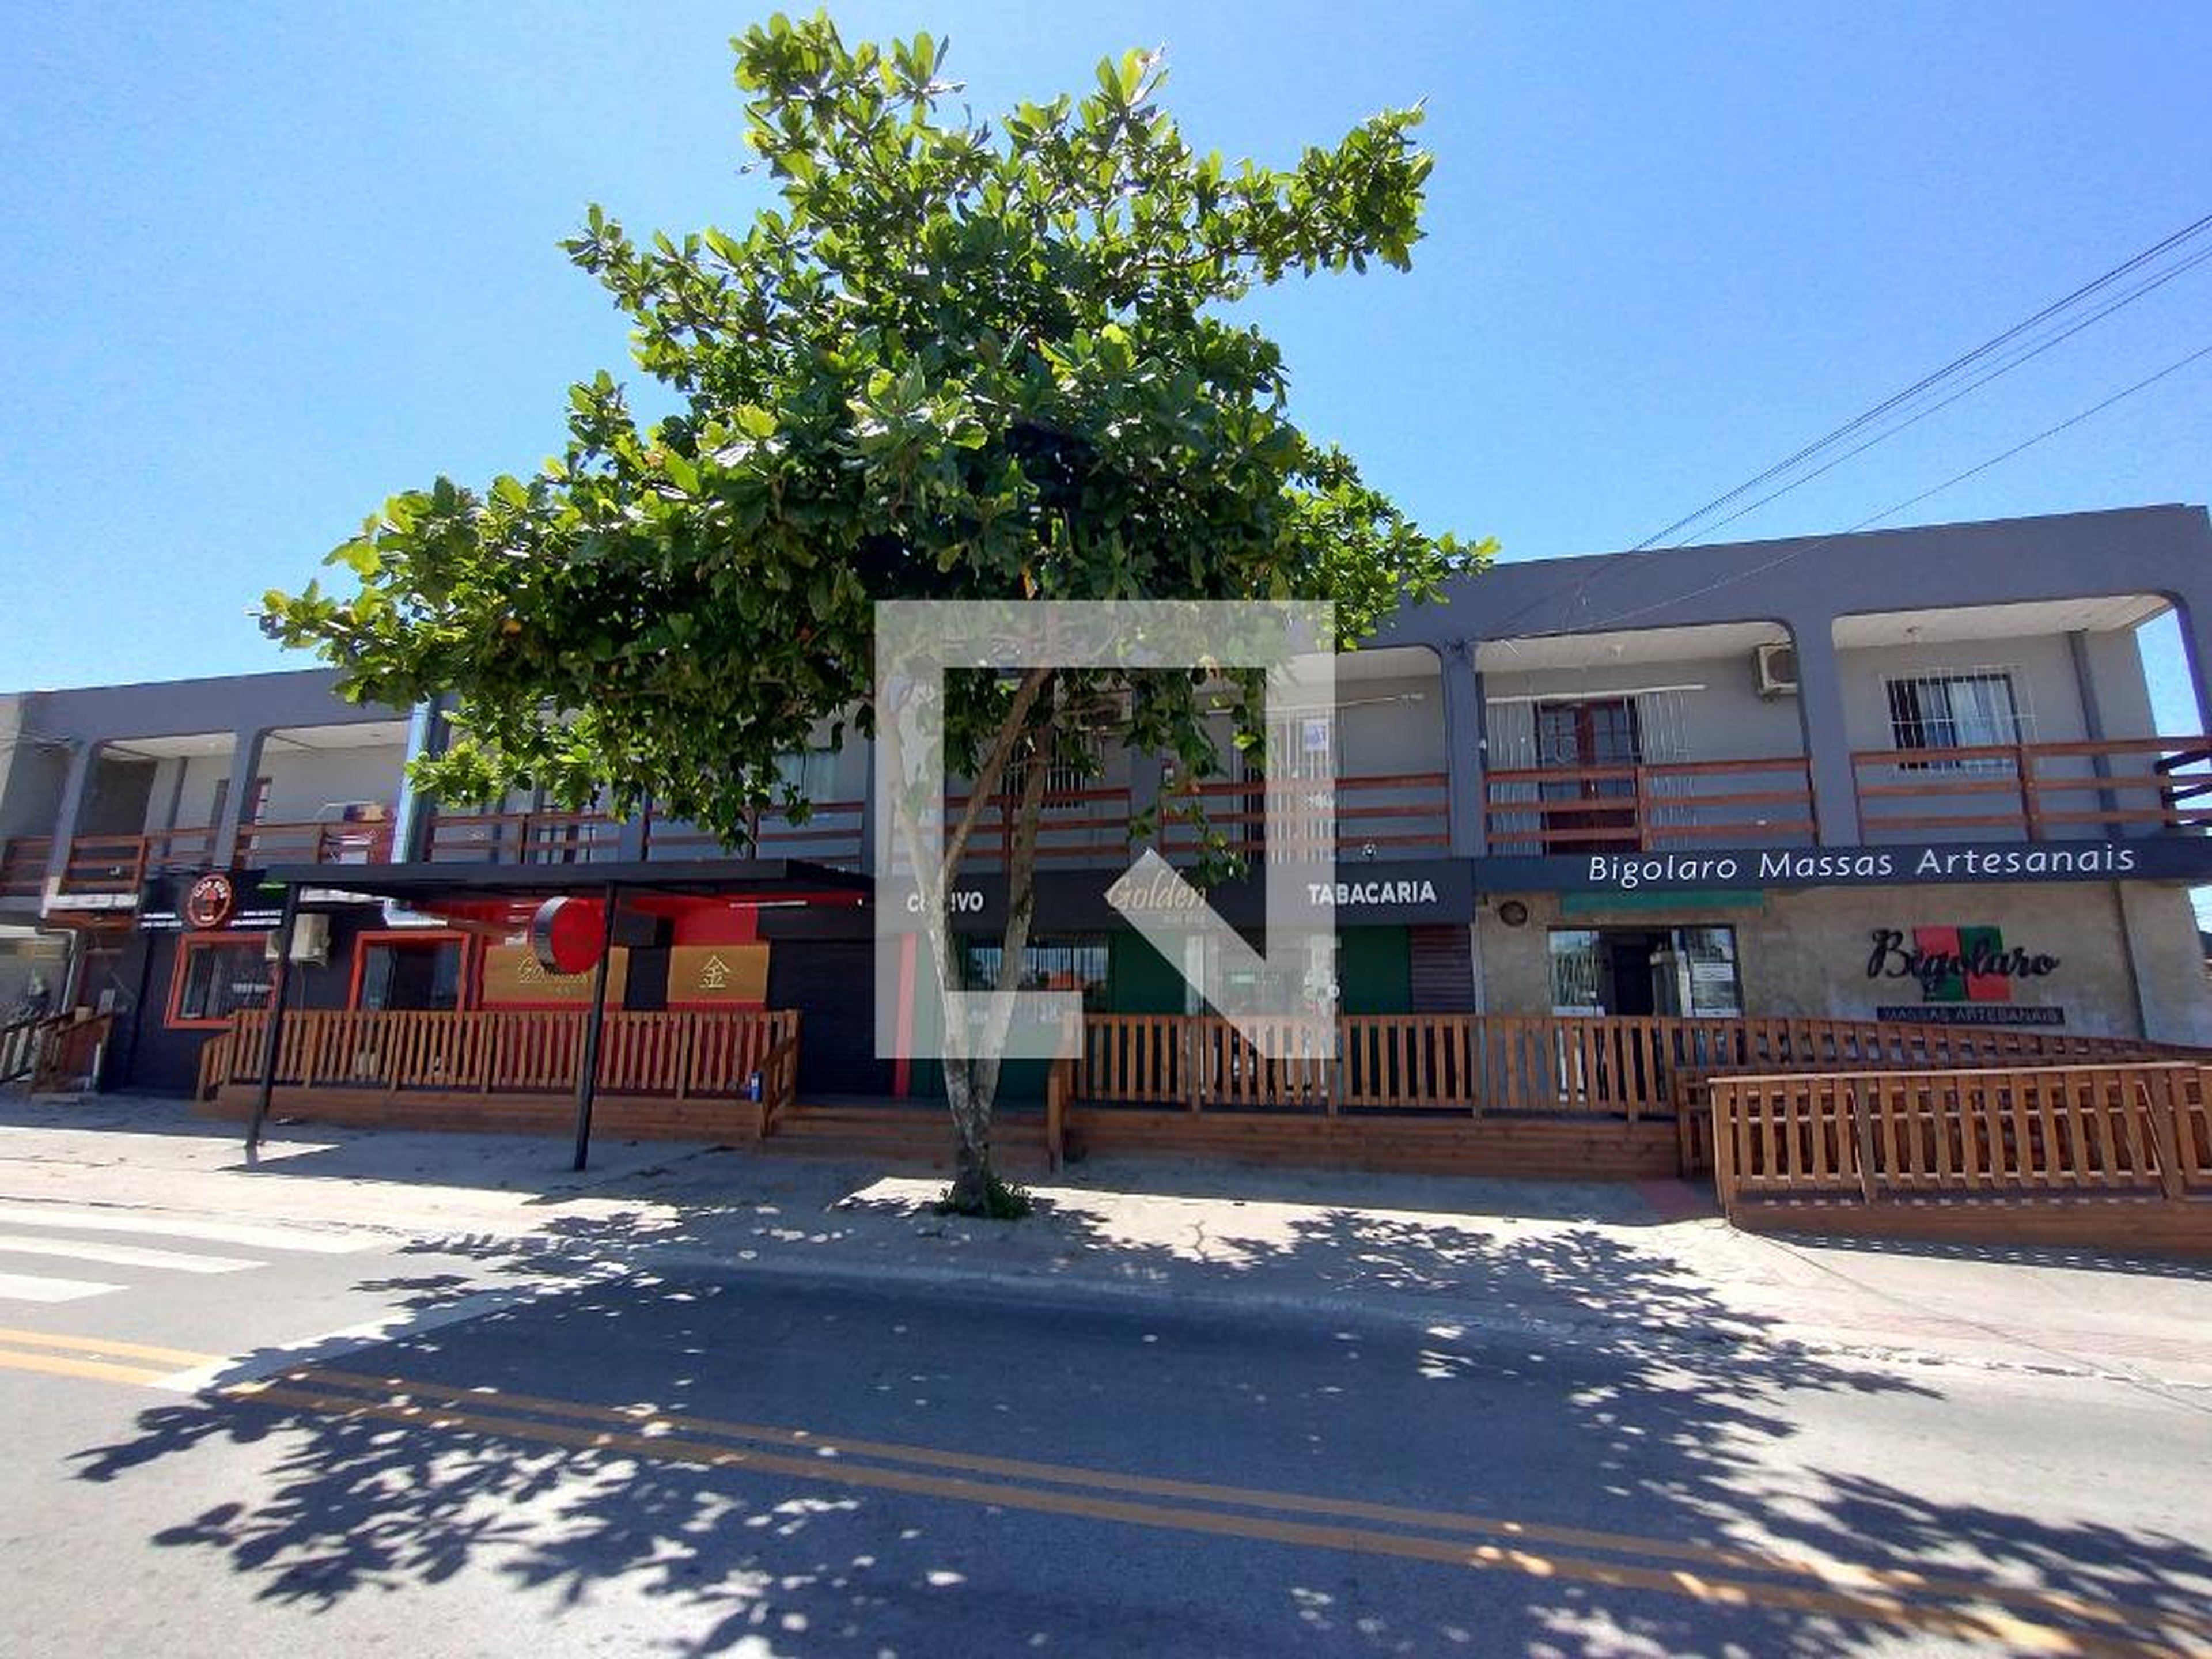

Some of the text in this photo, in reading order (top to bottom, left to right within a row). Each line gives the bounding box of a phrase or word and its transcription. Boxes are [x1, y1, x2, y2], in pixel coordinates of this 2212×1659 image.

[1589, 844, 2135, 889] Bigolaro Massas Artesanais
[1107, 868, 1206, 911] Golden
[1307, 880, 1437, 906] TABACARIA
[699, 955, 730, 988] 金
[1866, 928, 2061, 994] Bigolaro
